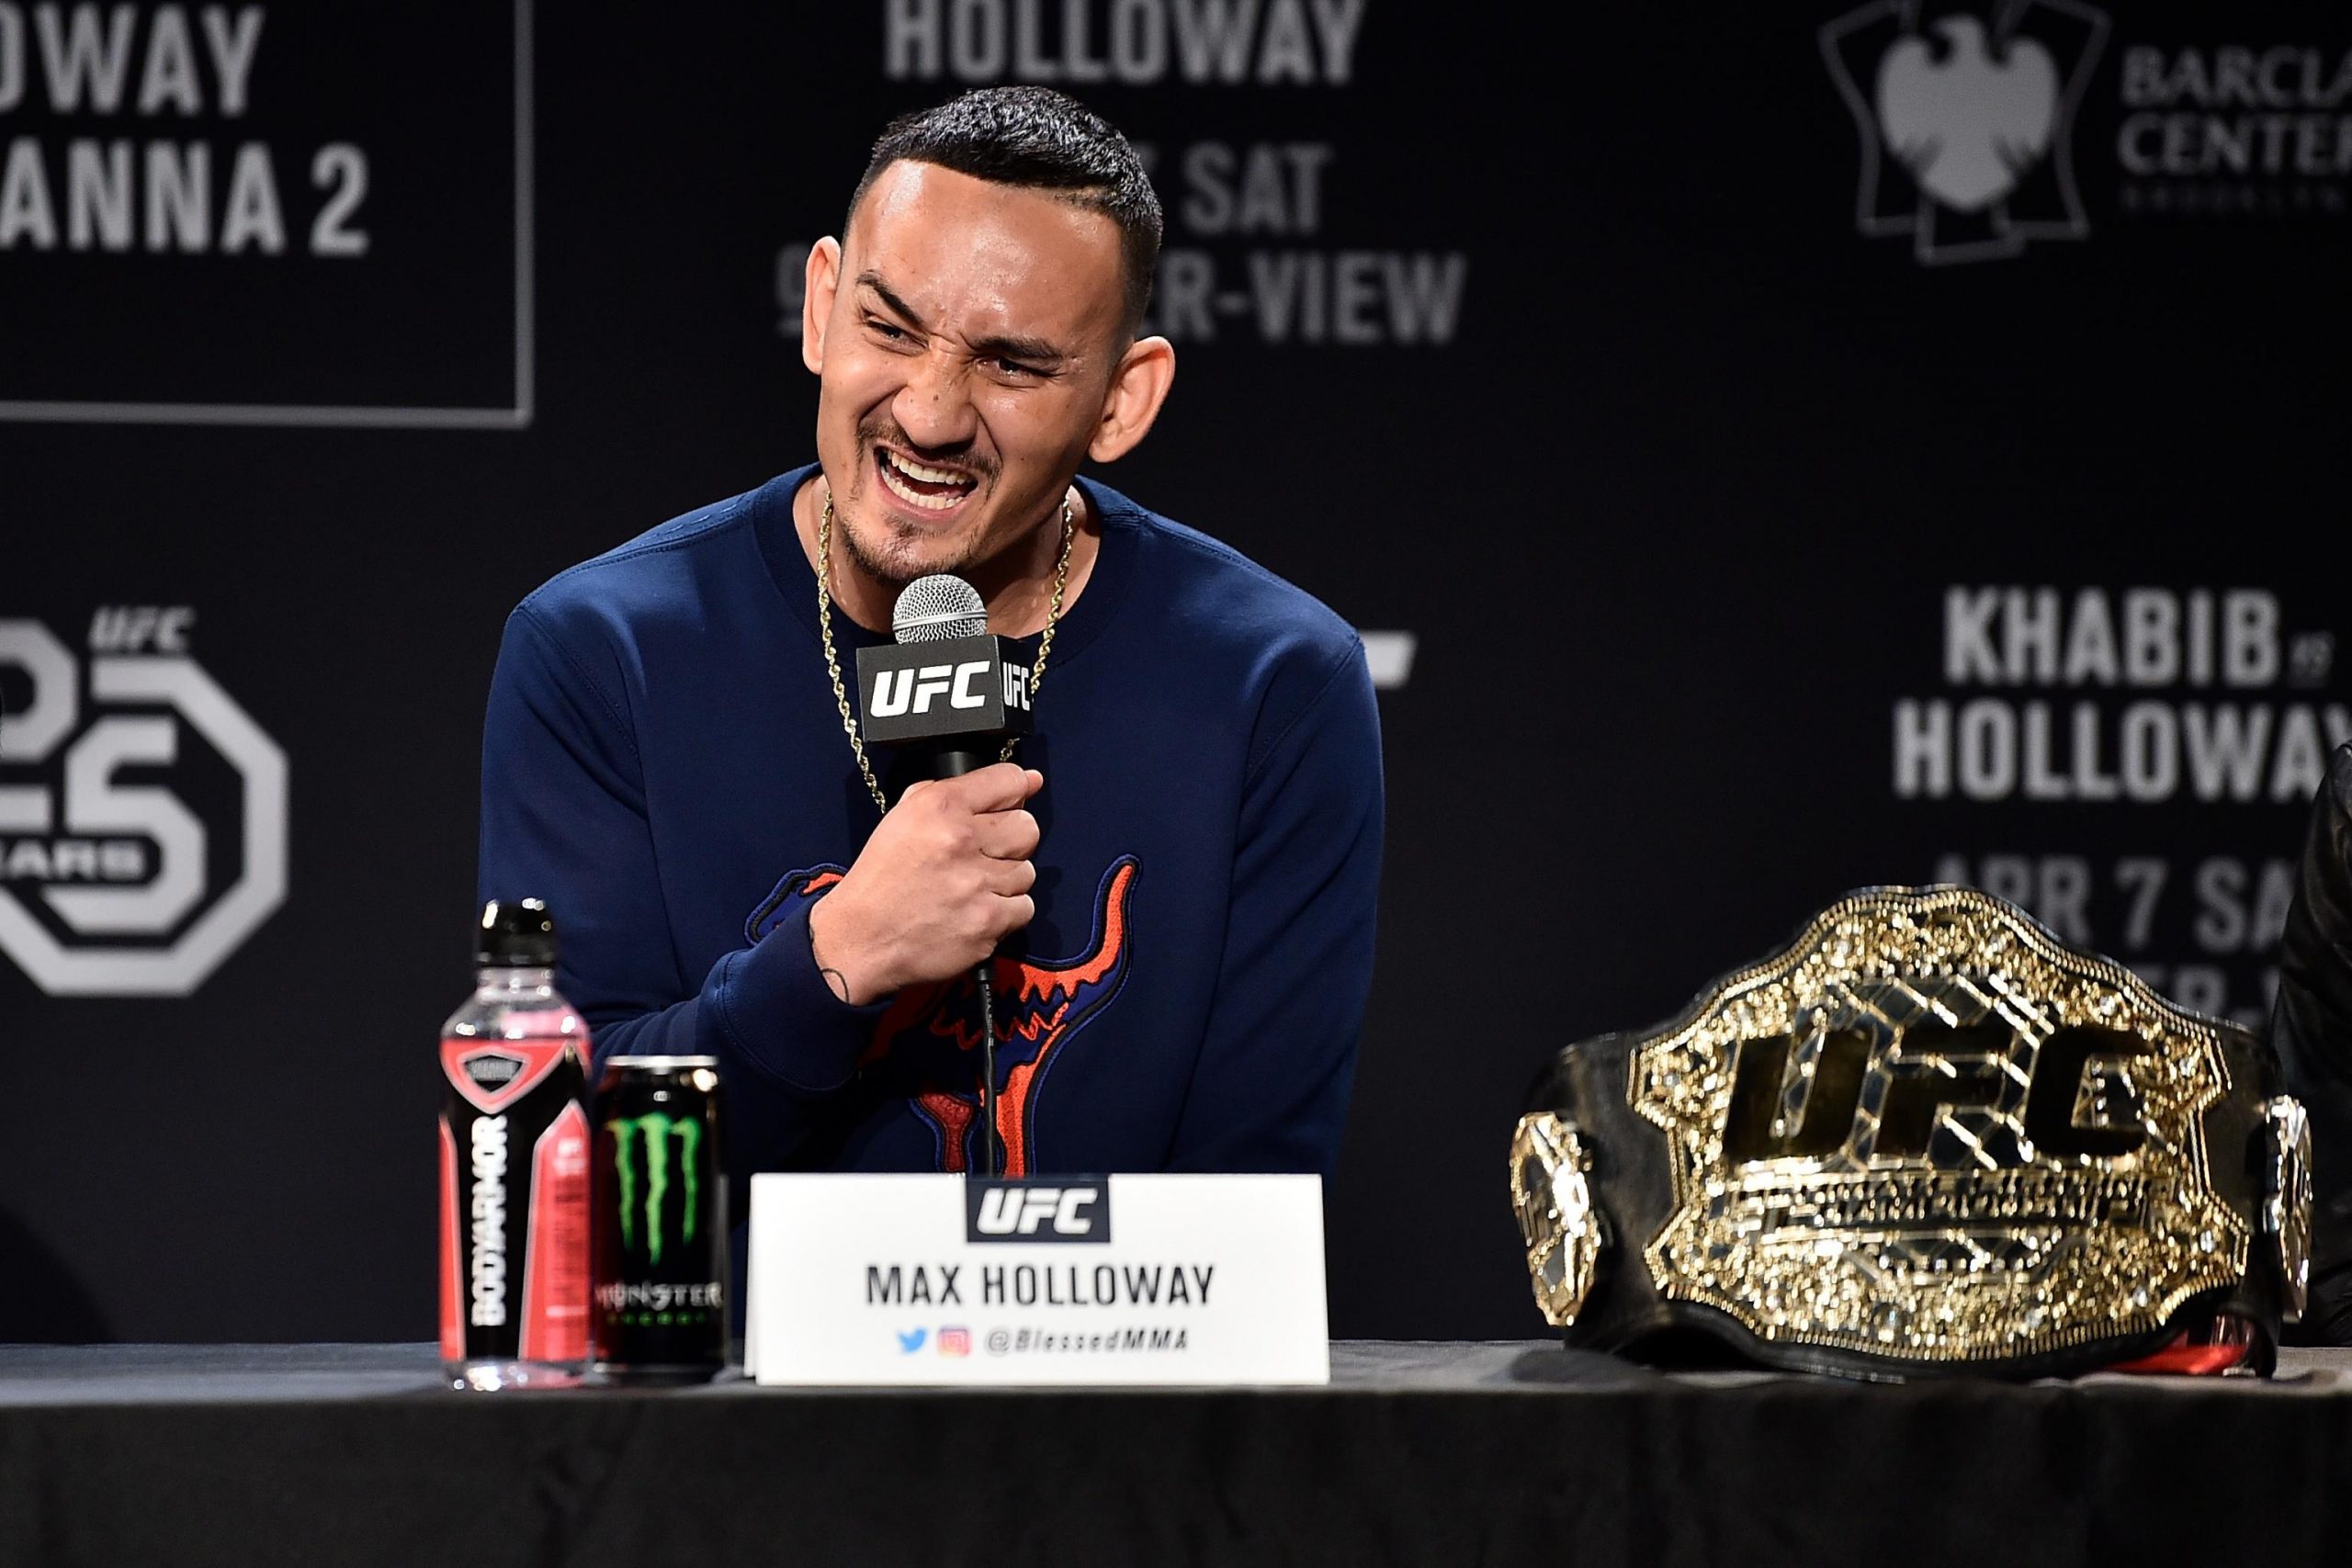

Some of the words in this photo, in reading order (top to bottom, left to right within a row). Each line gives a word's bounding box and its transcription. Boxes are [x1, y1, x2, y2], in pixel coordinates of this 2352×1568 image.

[884, 0, 1366, 85] HOLLOWAY
[0, 139, 285, 254] ANNA
[311, 143, 369, 256] 2
[1181, 139, 1332, 238] SAT
[1141, 251, 1469, 347] R-VIEW
[89, 604, 198, 652] UFC
[1942, 585, 2280, 687] KHABIB
[870, 660, 990, 718] UFC
[1002, 660, 1031, 712] UFC
[2113, 855, 2170, 952] 7
[1722, 1027, 2157, 1165] UFC
[471, 1114, 508, 1326] BODYARMOR
[977, 1188, 1099, 1235] UFC
[865, 1265, 963, 1306] MAX
[982, 1265, 1216, 1306] HOLLOWAY
[986, 1325, 1190, 1356] @BlessedMMA
